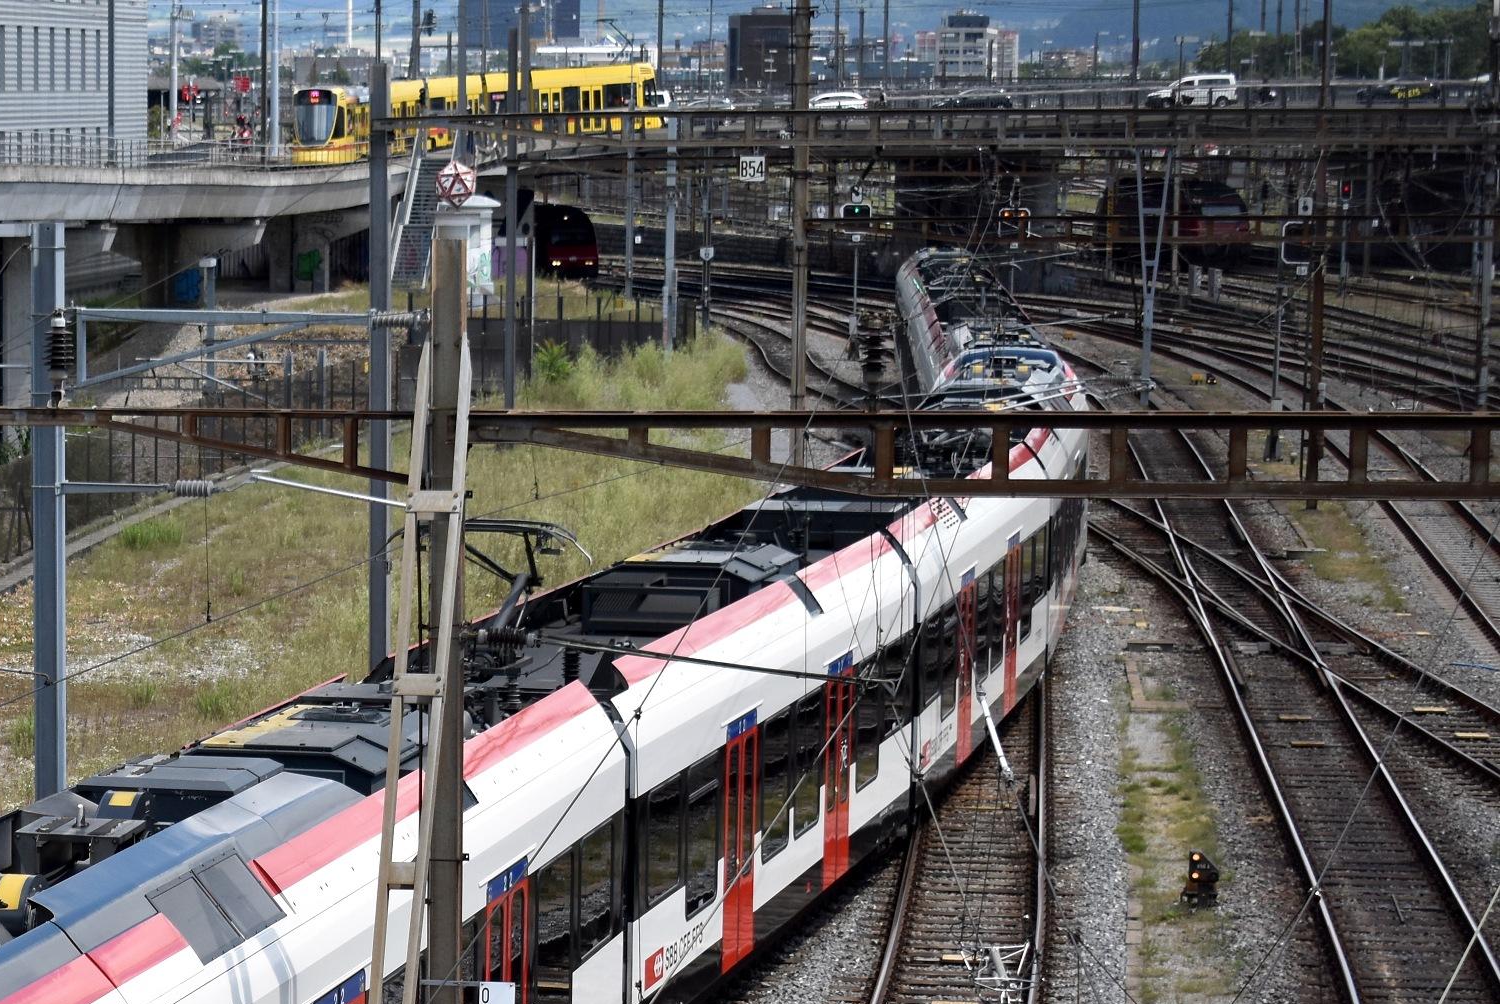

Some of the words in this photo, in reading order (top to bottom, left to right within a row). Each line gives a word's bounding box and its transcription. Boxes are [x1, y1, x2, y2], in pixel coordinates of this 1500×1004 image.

[740, 160, 765, 178] B54
[665, 942, 678, 970] SBB
[482, 987, 490, 1004] 0
